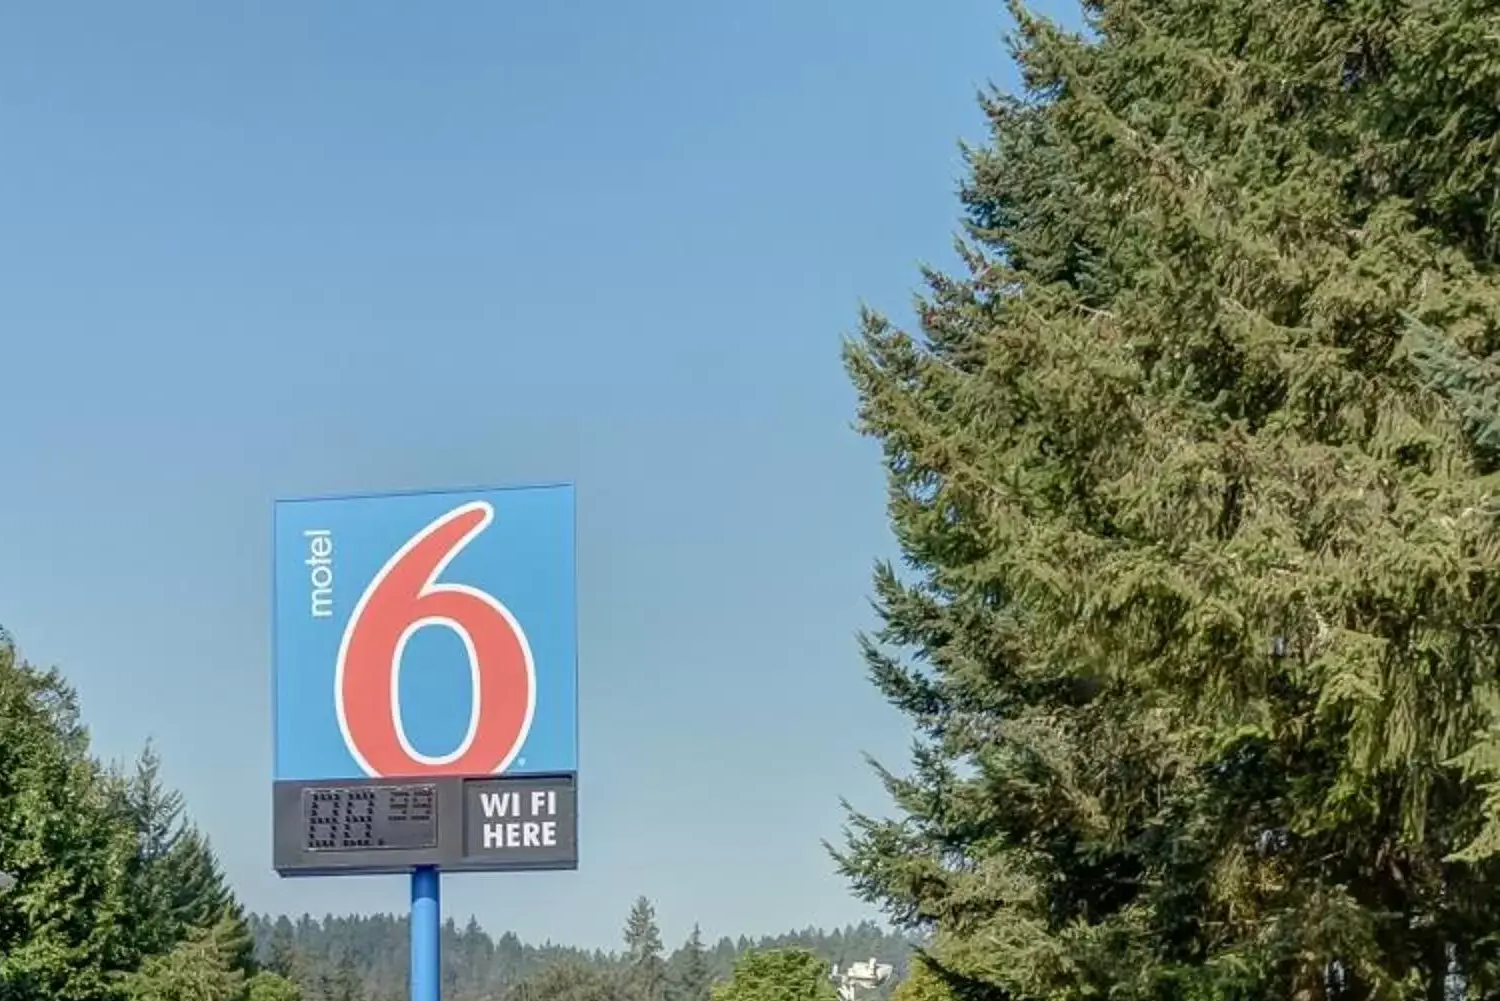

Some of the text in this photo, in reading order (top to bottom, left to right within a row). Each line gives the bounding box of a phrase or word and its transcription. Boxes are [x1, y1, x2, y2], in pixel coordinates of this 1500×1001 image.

[303, 528, 333, 618] motel
[334, 499, 537, 778] 6
[480, 790, 557, 818] WI FI
[482, 821, 558, 849] HERE
